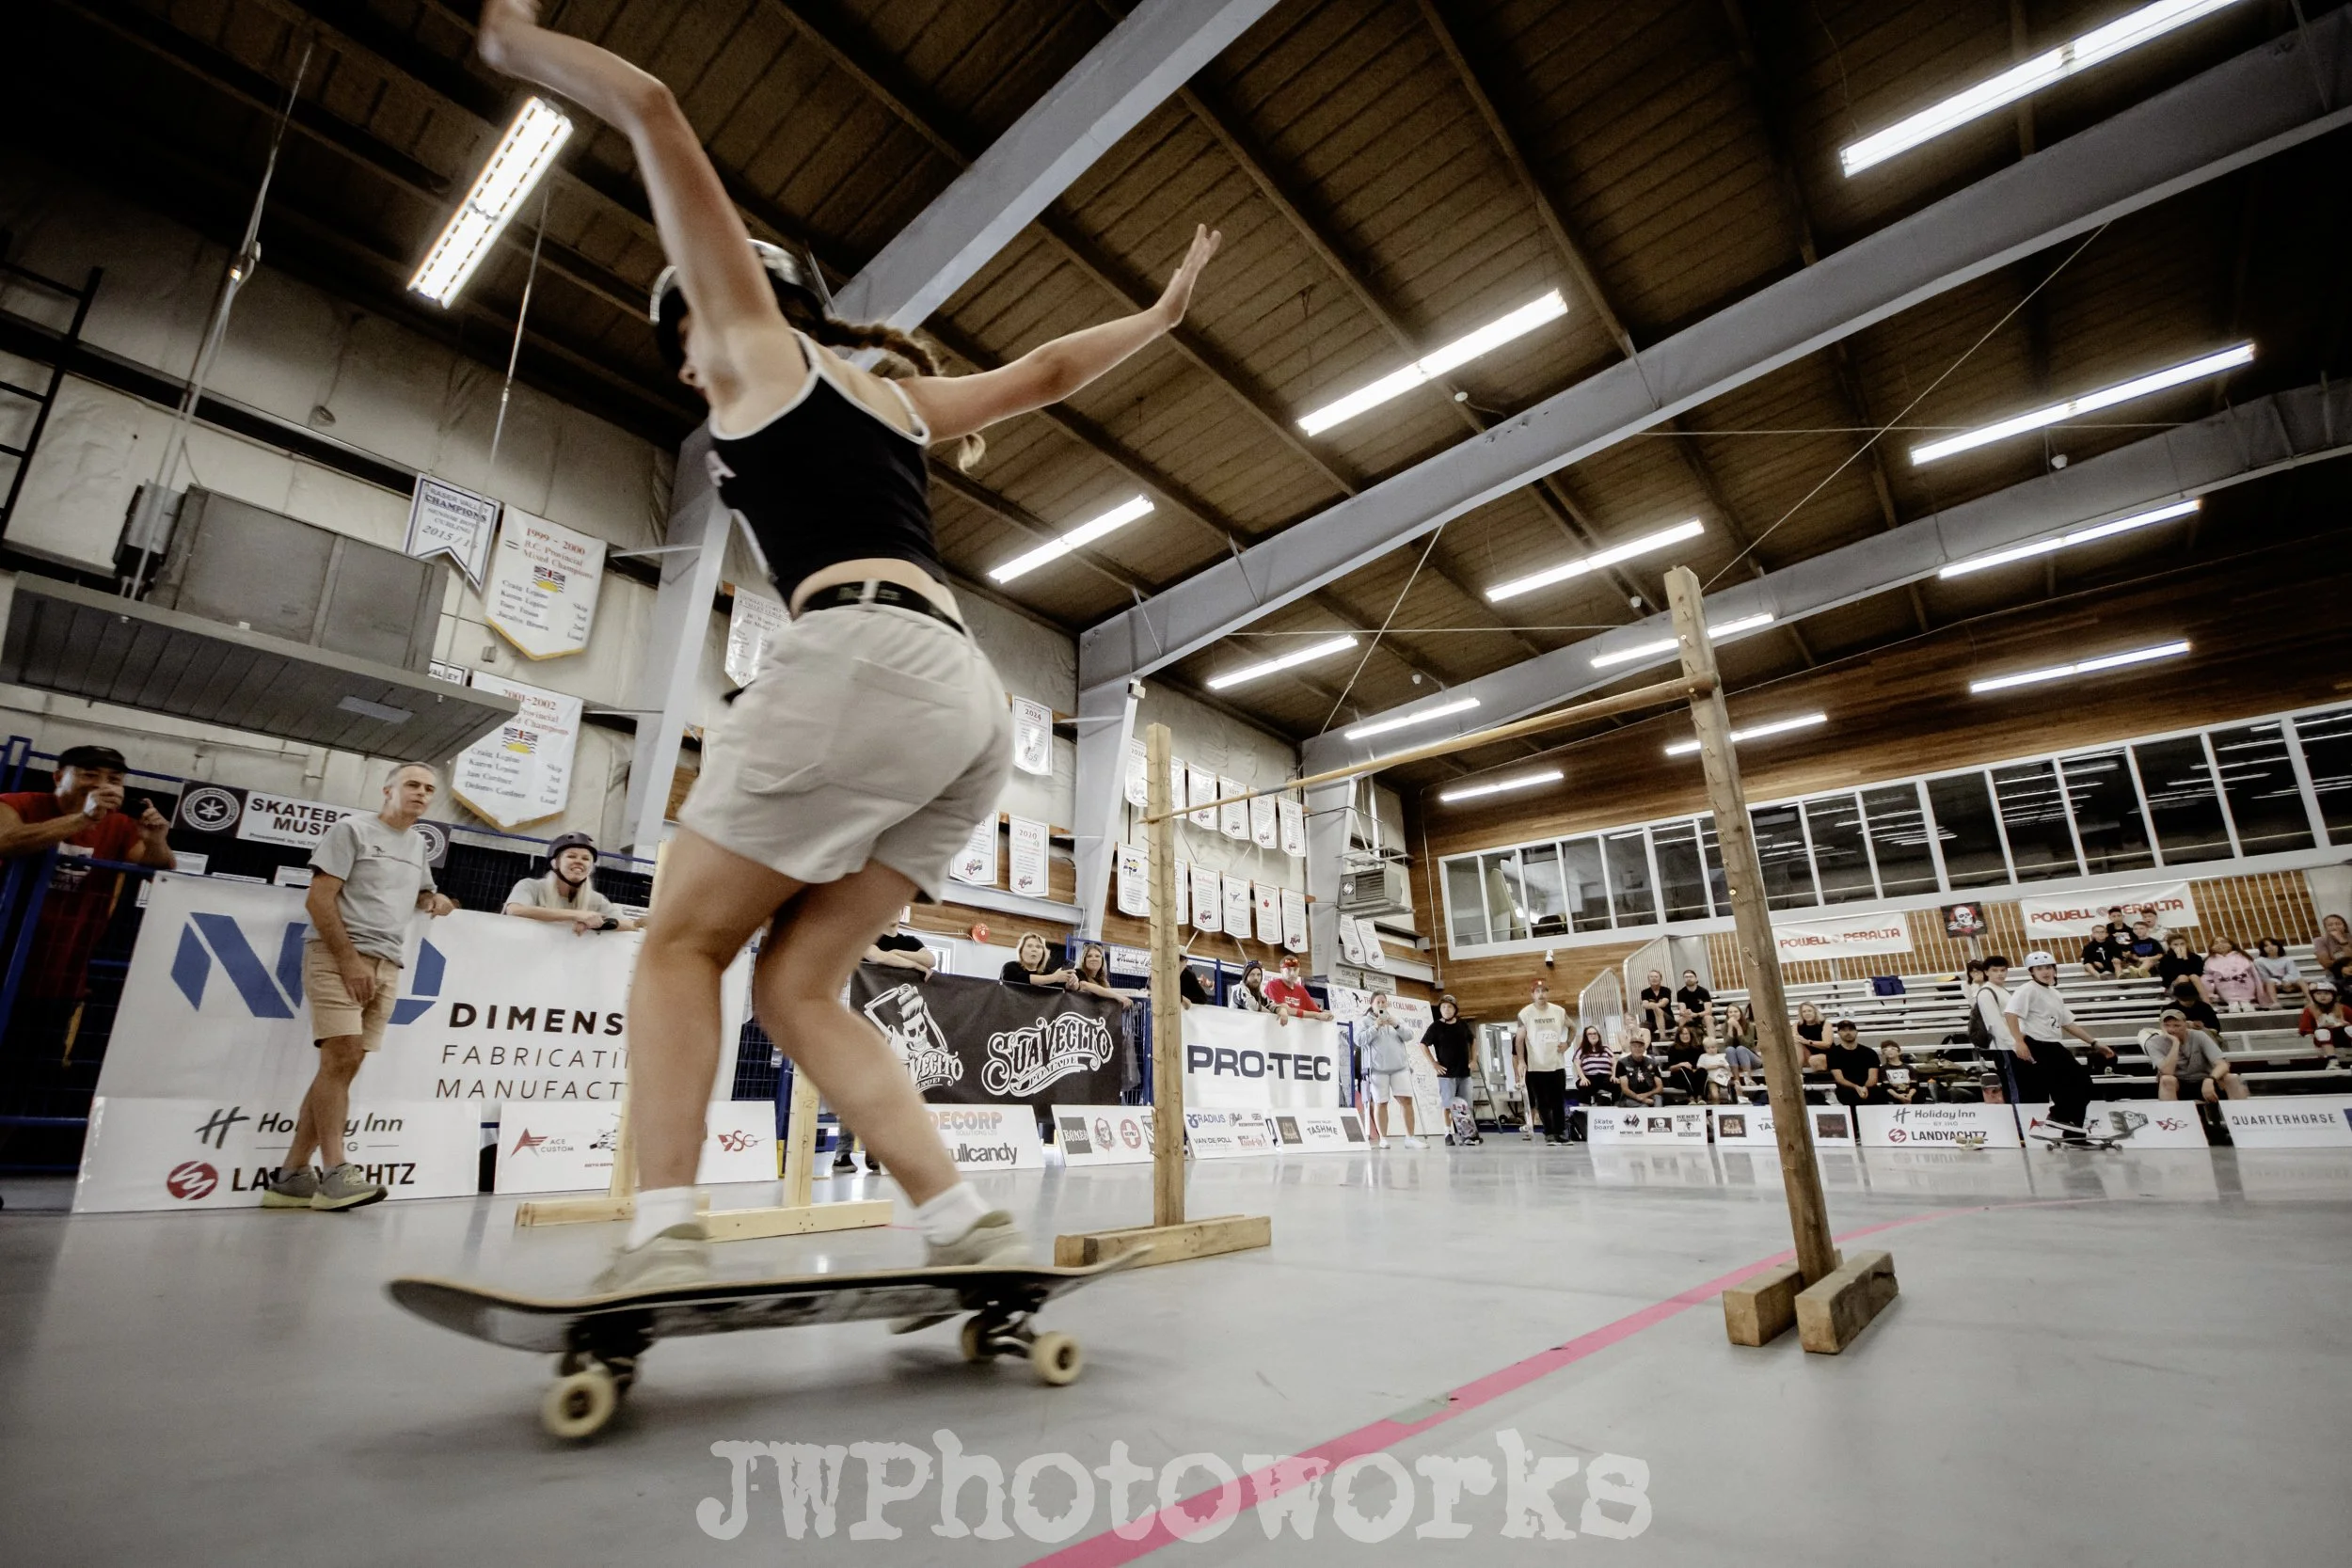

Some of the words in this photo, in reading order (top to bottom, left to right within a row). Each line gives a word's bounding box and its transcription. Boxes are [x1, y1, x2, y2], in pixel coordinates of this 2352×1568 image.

[424, 494, 486, 522] CHAMPIONS
[544, 546, 583, 566] Provincial
[563, 541, 585, 555] 2000
[551, 559, 594, 579] Champions
[1025, 708, 1041, 721] 2024
[524, 718, 569, 736] Champions
[250, 798, 352, 823] SKATEB
[1019, 829, 1038, 840] 2020
[2030, 909, 2095, 924] POWELL
[1780, 936, 1831, 948] POWELL
[1843, 928, 1900, 942] PERALTA
[442, 1044, 629, 1069] FABRICATI
[981, 1012, 1114, 1096] SUAVECITO
[1029, 1055, 1078, 1085] POMADE
[364, 1112, 404, 1132] Inn
[1197, 1114, 1226, 1124] RADIUS
[1915, 1109, 1956, 1120] Holiday
[1958, 1109, 1976, 1118] Inn
[2232, 1113, 2337, 1126] QUARTERHORSE
[1307, 1124, 1339, 1136] TASHME
